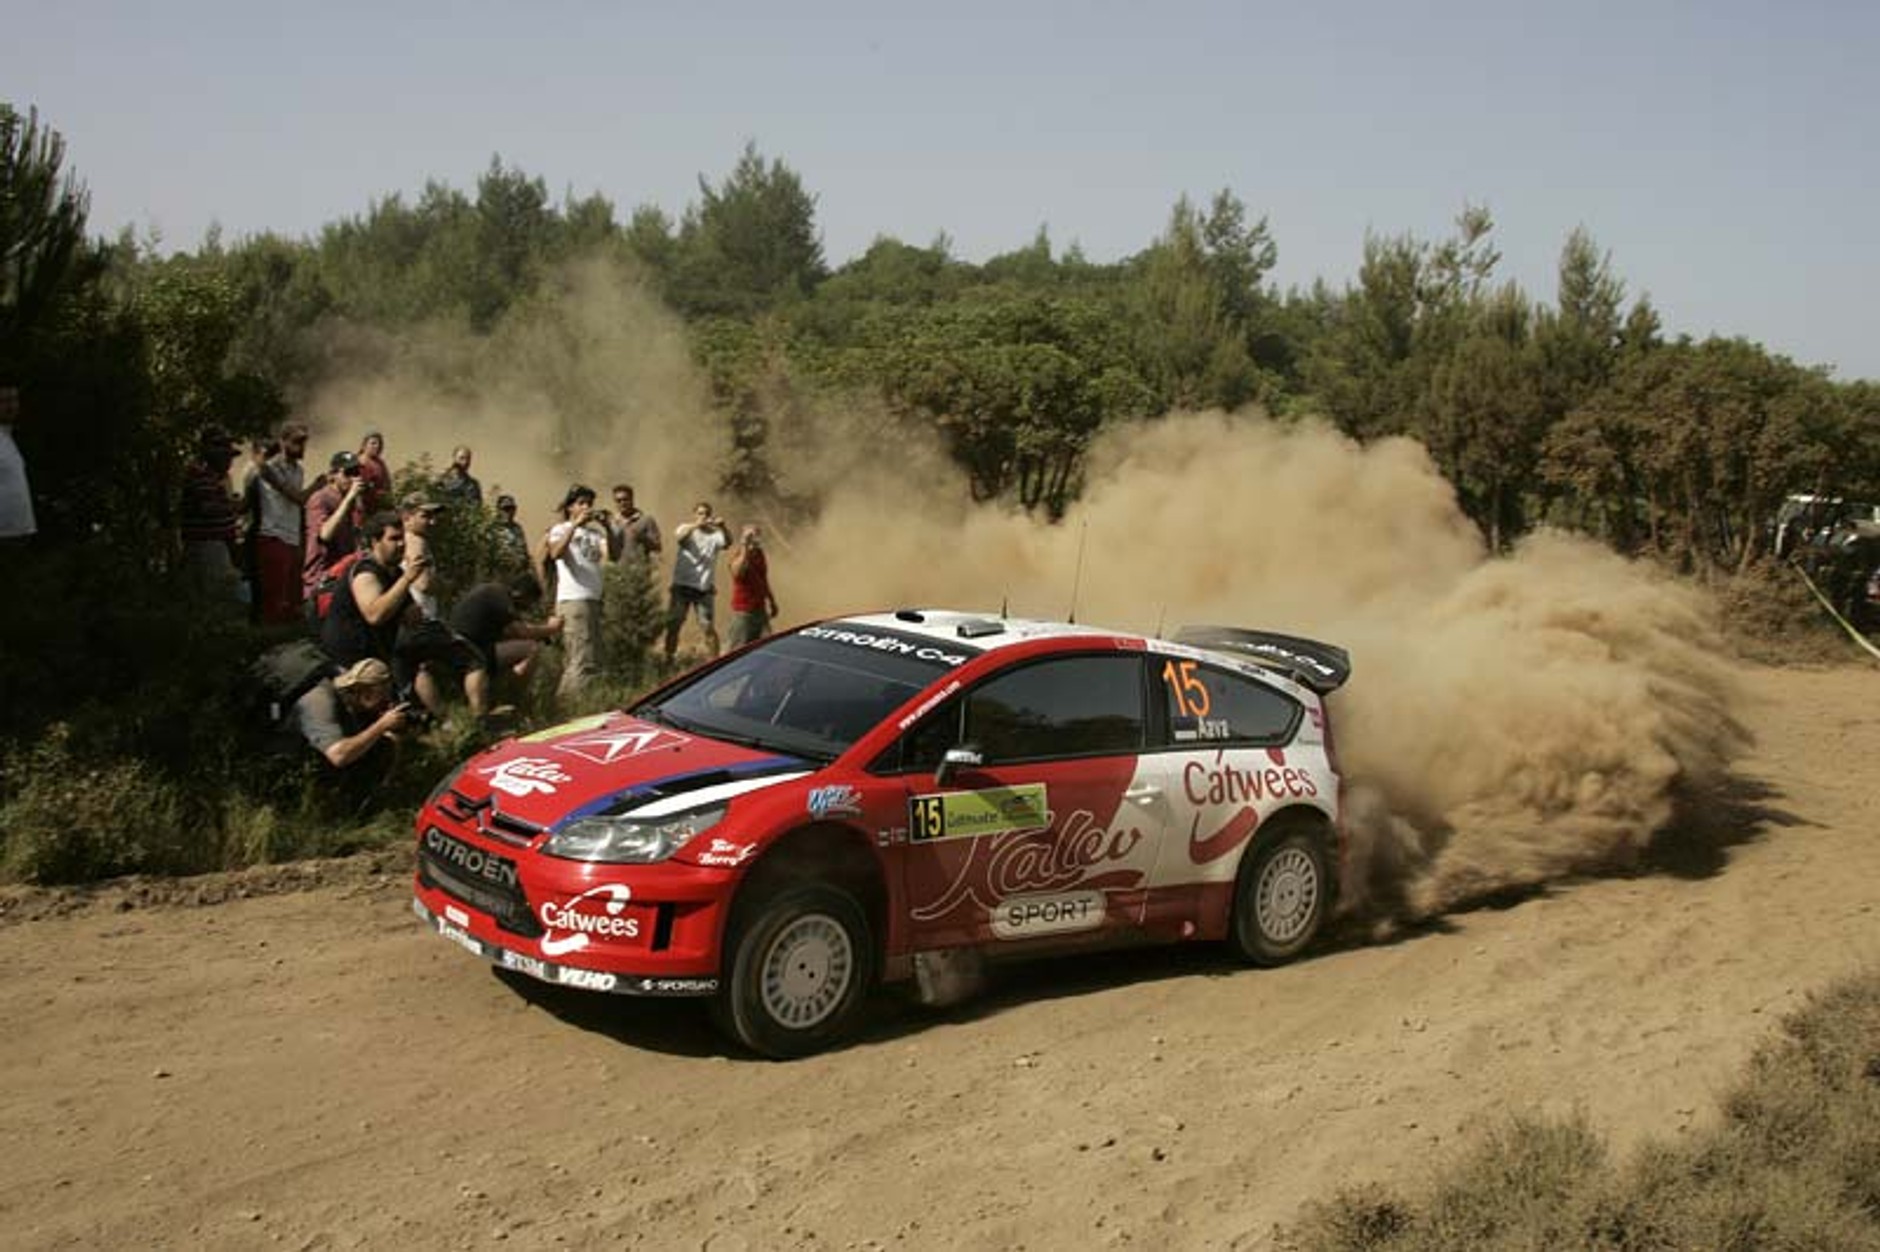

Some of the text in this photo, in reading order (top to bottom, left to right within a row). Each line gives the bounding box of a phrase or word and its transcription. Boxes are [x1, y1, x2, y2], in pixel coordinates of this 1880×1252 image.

[916, 648, 967, 666] C4
[1163, 660, 1211, 717] 15
[1184, 761, 1317, 806] Catwees
[914, 800, 942, 838] 15
[427, 827, 518, 886] CITROËN
[541, 902, 639, 937] Catwees
[1008, 900, 1092, 928] SPORT
